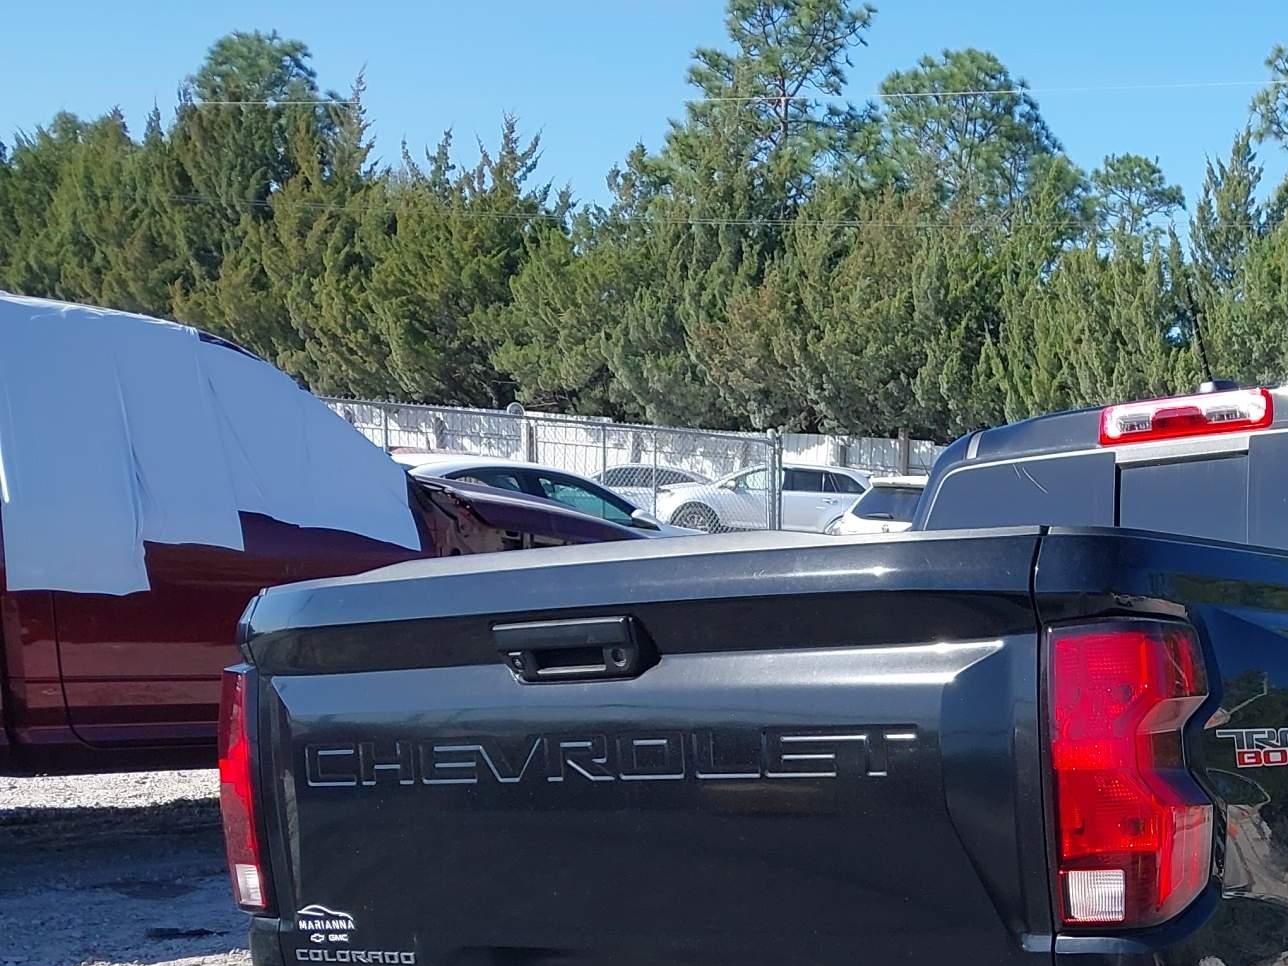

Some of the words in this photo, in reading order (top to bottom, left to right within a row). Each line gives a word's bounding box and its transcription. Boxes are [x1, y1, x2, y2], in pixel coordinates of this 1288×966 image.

[305, 723, 918, 788] CHEVROLET
[298, 919, 355, 930] MARIANNA
[328, 934, 349, 942] GMC
[295, 949, 416, 965] COLORADO
